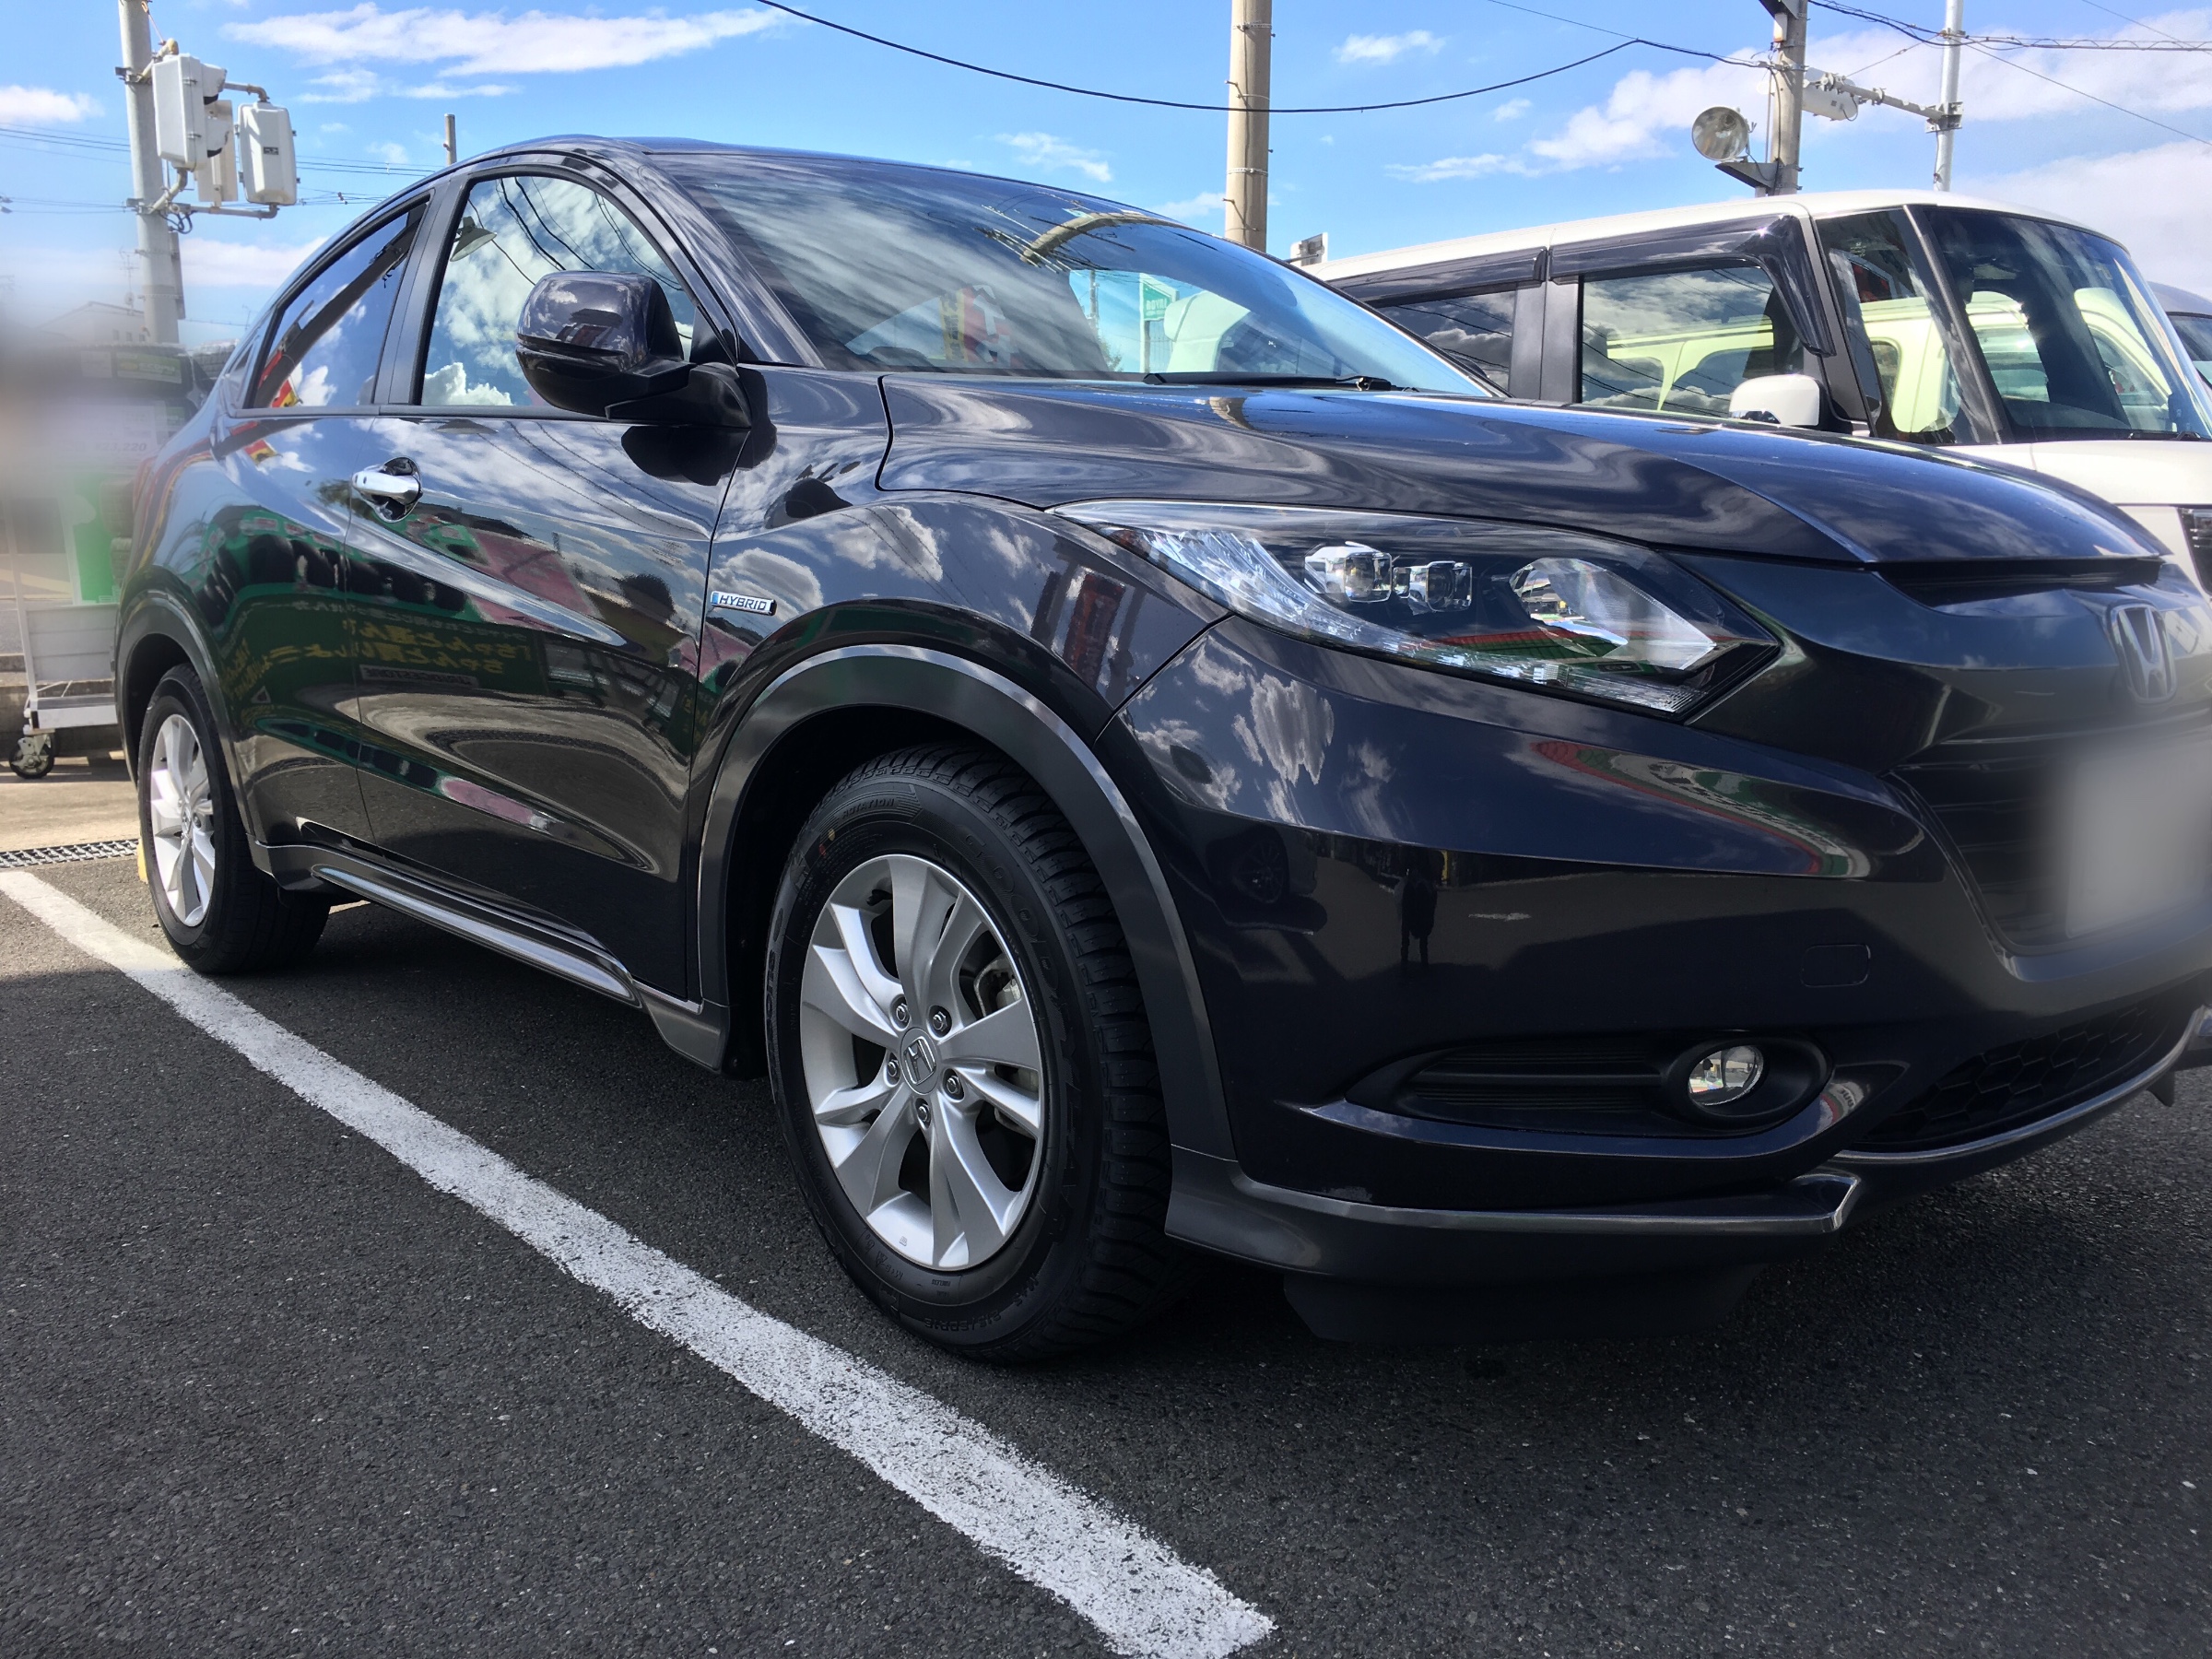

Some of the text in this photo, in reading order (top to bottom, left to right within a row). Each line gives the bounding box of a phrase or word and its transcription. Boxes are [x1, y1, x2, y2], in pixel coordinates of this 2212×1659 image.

[719, 594, 767, 611] HYBRID
[841, 798, 895, 818] ROTATION
[962, 828, 1077, 1244] GOODYEAR
